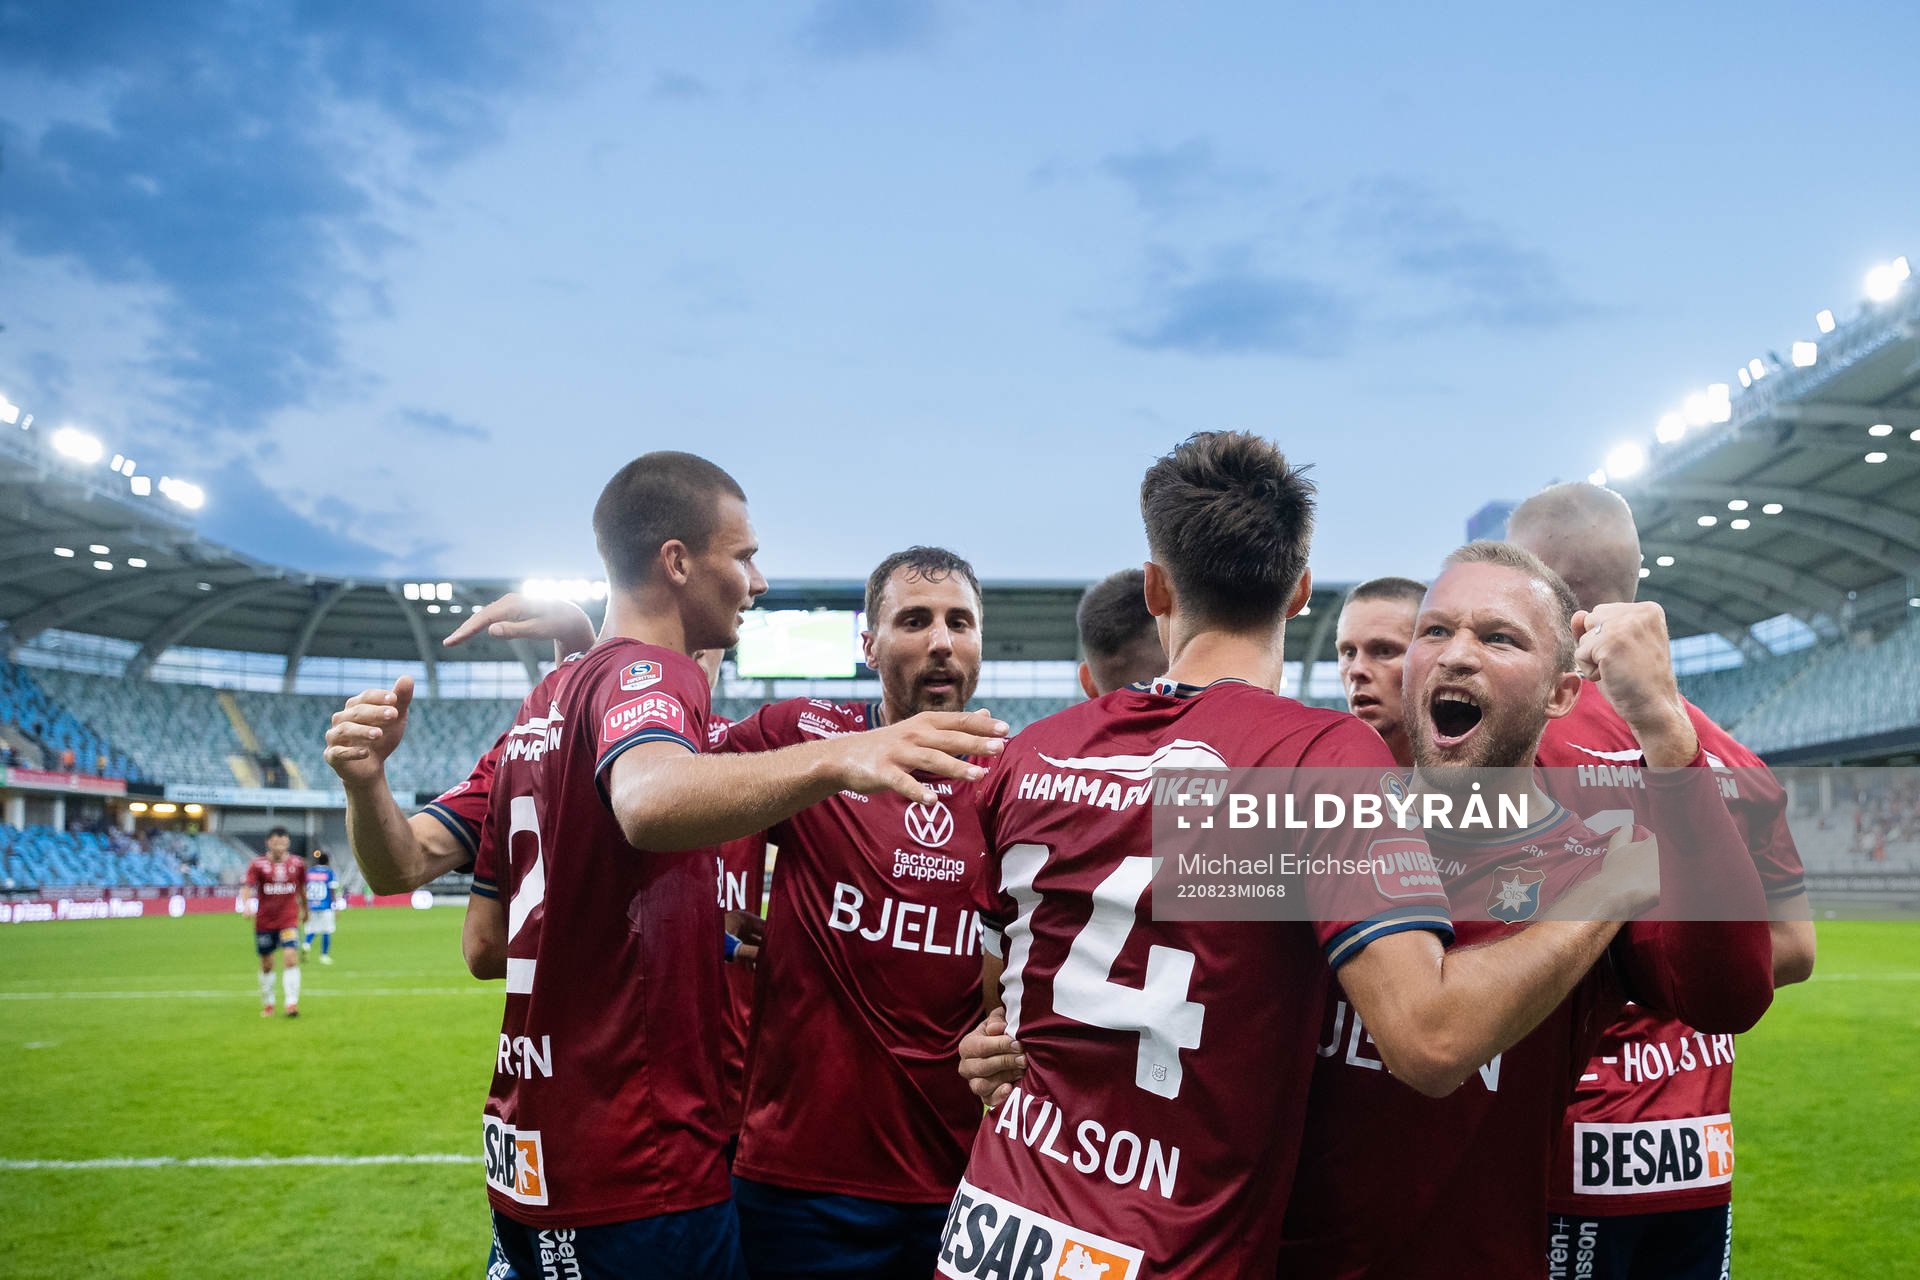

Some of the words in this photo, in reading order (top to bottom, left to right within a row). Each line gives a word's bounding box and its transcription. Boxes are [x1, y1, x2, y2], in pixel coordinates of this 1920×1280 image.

[610, 698, 680, 728] UNIBET
[800, 711, 840, 731] KÄLLFELT
[838, 789, 869, 803] mbro
[892, 862, 957, 883] gruppen
[893, 848, 966, 876] factoring
[998, 843, 1206, 1101] 14
[483, 1123, 517, 1189] SAB
[995, 1086, 1181, 1200] AULSON
[1581, 1127, 1703, 1187] BESAB
[554, 1228, 582, 1280] Sem
